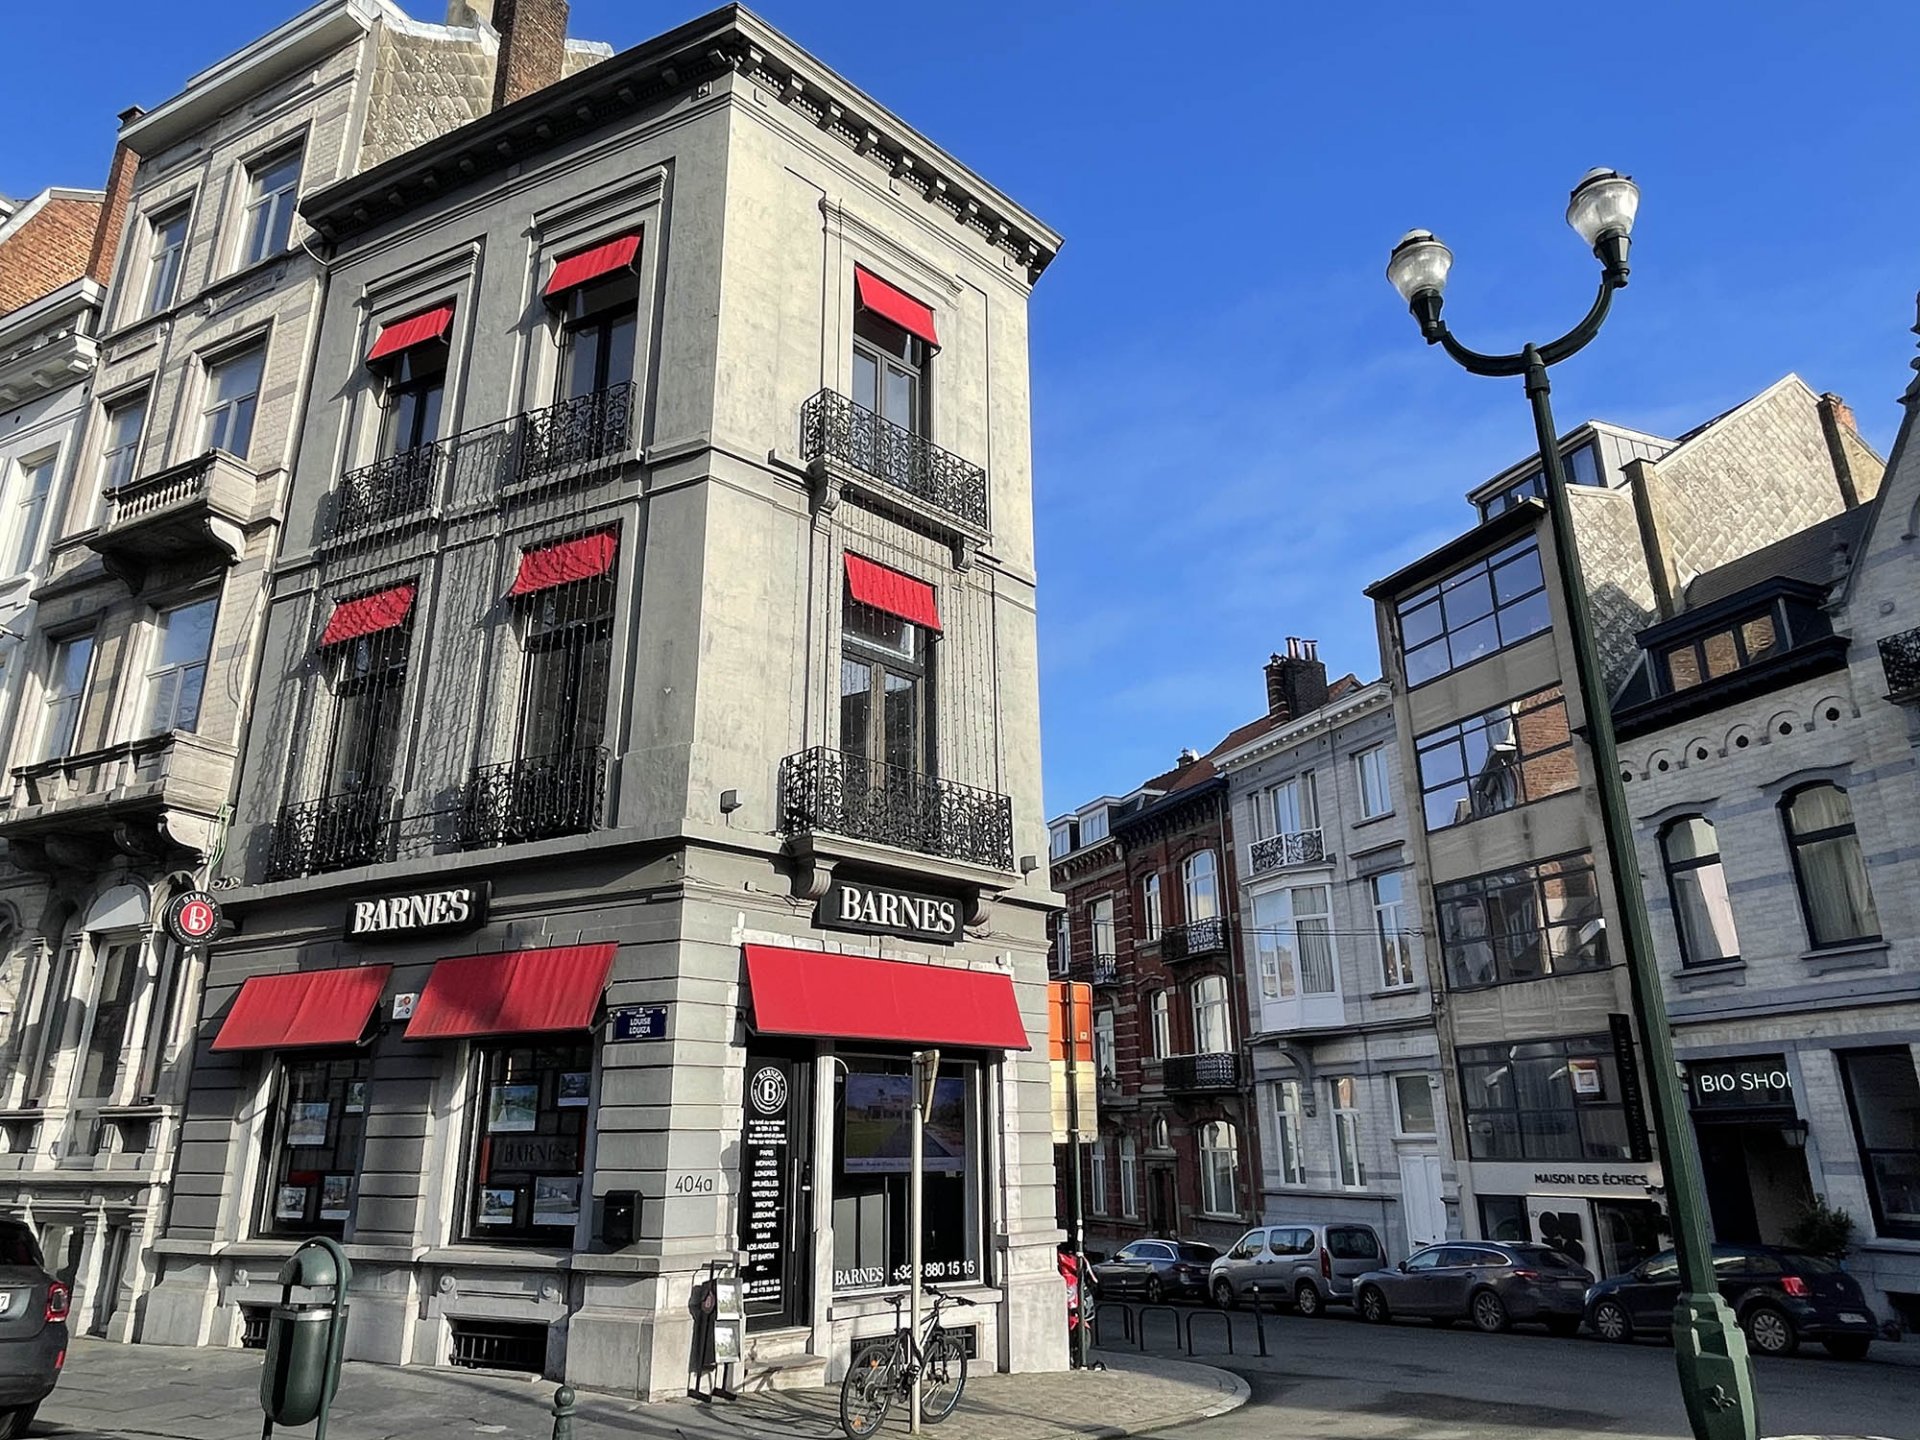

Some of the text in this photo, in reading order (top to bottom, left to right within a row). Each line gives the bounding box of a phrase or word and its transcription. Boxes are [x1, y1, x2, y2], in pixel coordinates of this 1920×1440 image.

[182, 893, 217, 910] BARNES
[840, 885, 956, 934] BARNES
[188, 905, 208, 930] B
[351, 888, 470, 934] BARNES
[629, 1026, 651, 1035] LOUIZA
[630, 1017, 651, 1026] LOUISE
[763, 1080, 777, 1101] B
[1700, 1074, 1736, 1092] BIO
[675, 1175, 713, 1193] 404a
[1534, 1172, 1648, 1186] MAISON DES ÉCHECS
[834, 1267, 884, 1286] BARNES
[893, 1264, 912, 1280] +32
[924, 1262, 945, 1278] 880
[947, 1261, 960, 1275] 15
[962, 1260, 975, 1274] 15
